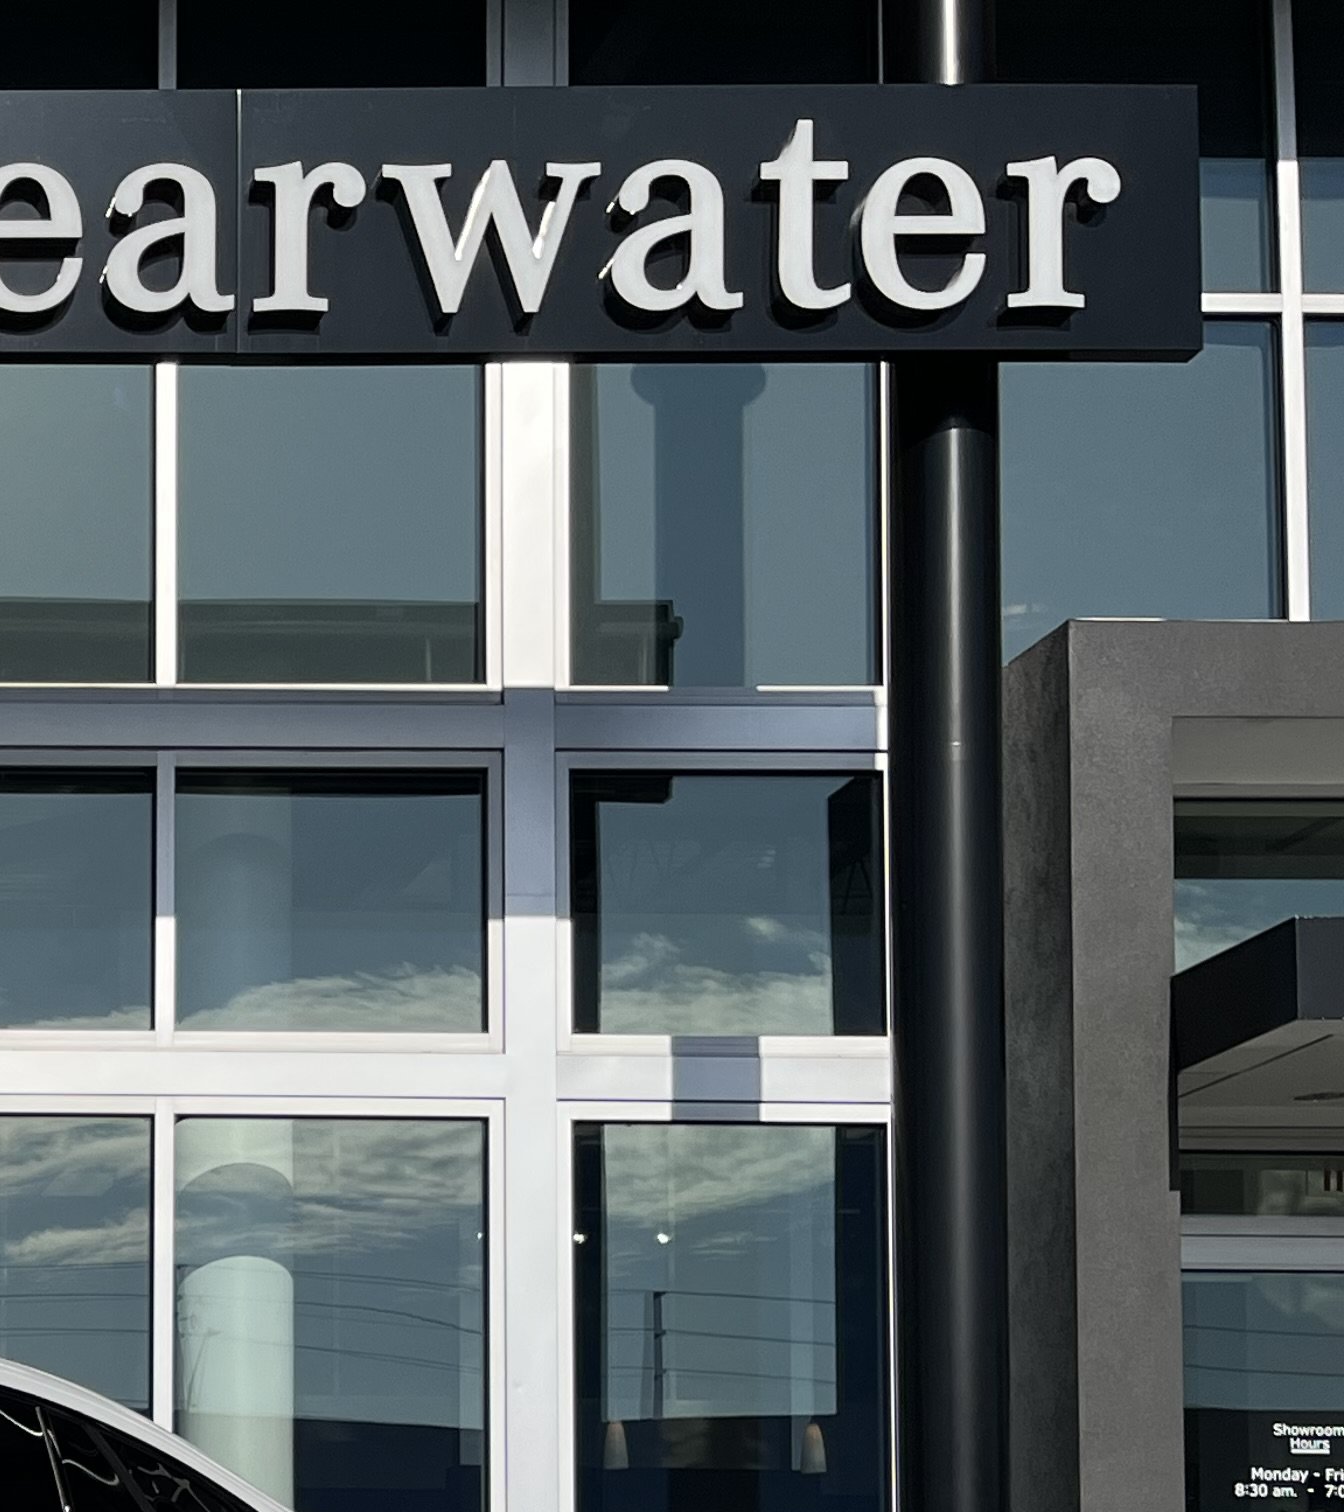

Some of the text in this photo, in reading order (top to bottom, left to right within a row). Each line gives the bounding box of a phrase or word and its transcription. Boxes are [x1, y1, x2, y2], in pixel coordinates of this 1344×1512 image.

[1273, 1423, 1344, 1436] Showroom
[1290, 1437, 1330, 1450] Hours
[1251, 1466, 1309, 1484] Monday
[1234, 1483, 1268, 1497] 8:30
